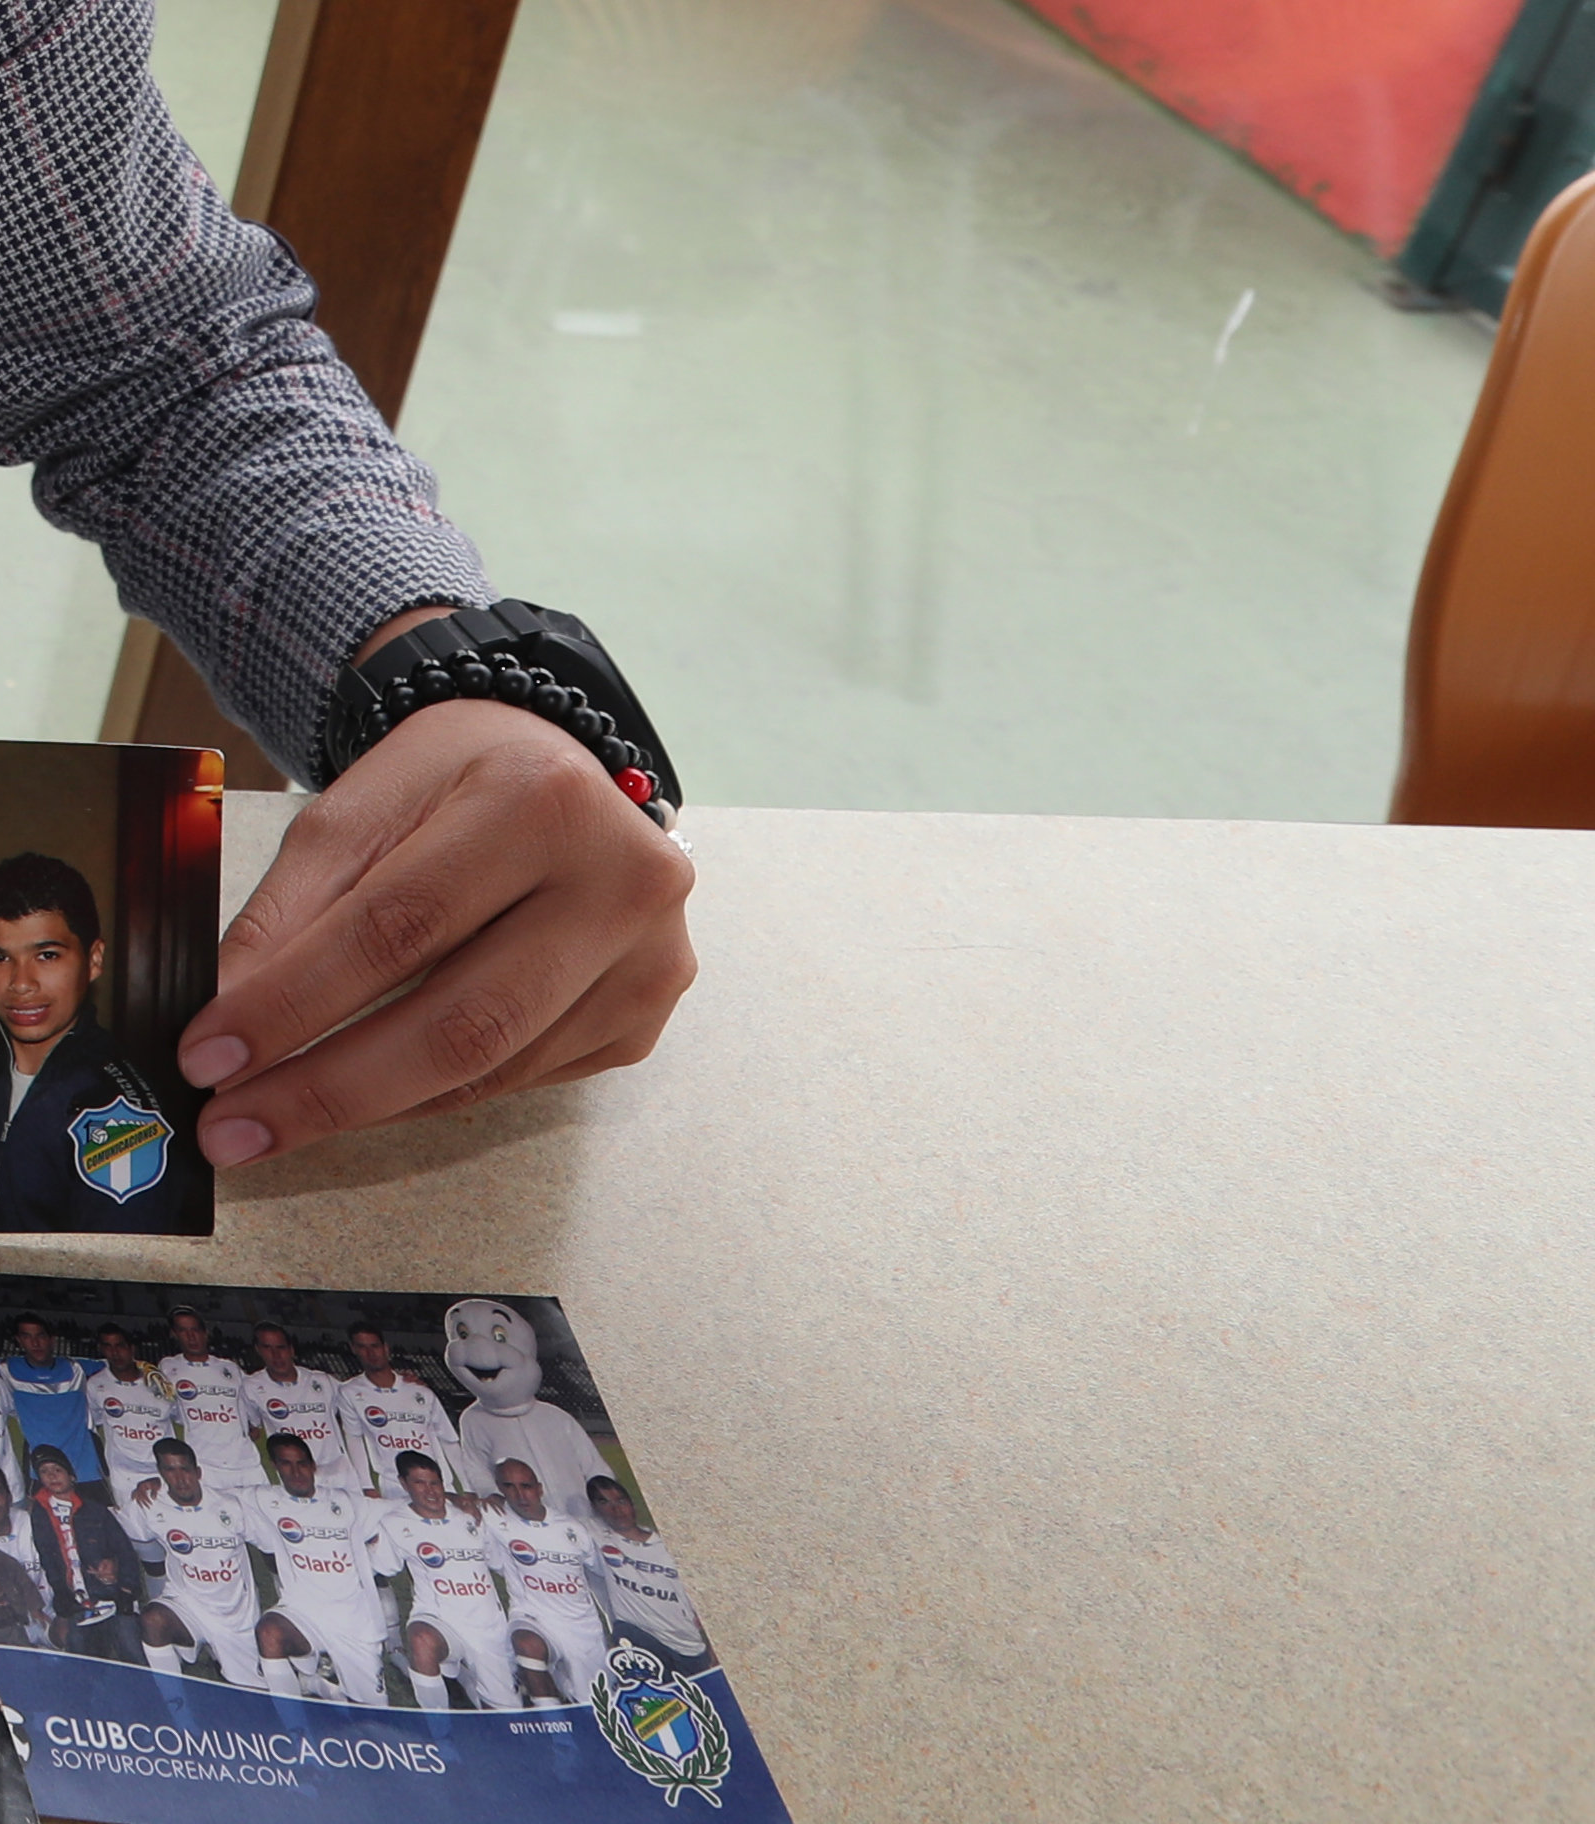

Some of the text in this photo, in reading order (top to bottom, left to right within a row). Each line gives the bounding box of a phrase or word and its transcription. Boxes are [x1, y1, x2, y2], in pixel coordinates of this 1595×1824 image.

[86, 1124, 158, 1171] COMUNICACIONES
[510, 1721, 573, 1735] 07/11/2007
[51, 1748, 299, 1788] SOYPUROCREMA.COM
